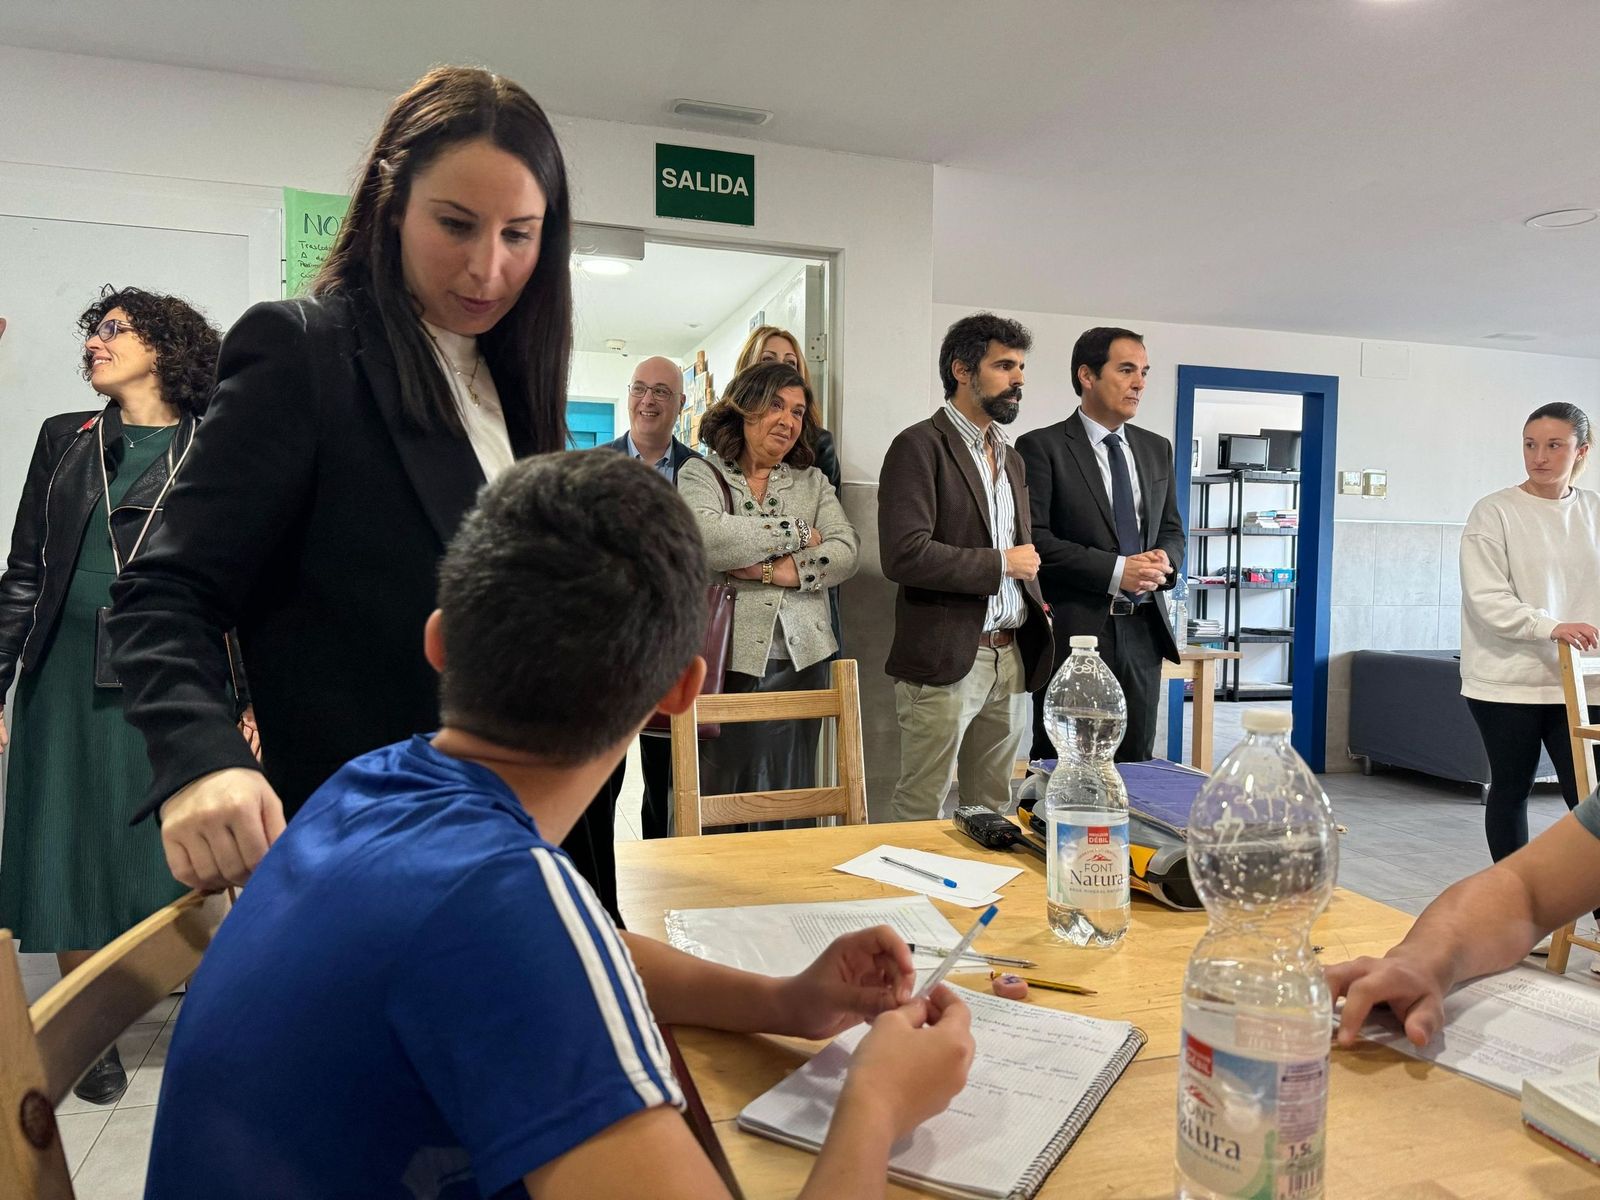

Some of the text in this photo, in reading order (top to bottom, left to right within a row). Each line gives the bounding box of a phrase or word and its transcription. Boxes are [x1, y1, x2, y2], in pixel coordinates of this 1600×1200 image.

[662, 167, 749, 196] SALIDA
[304, 213, 345, 236] NO
[1070, 869, 1124, 887] Natura
[1084, 863, 1113, 873] FONT
[1182, 1095, 1217, 1127] ONT
[1180, 1117, 1240, 1161] atura
